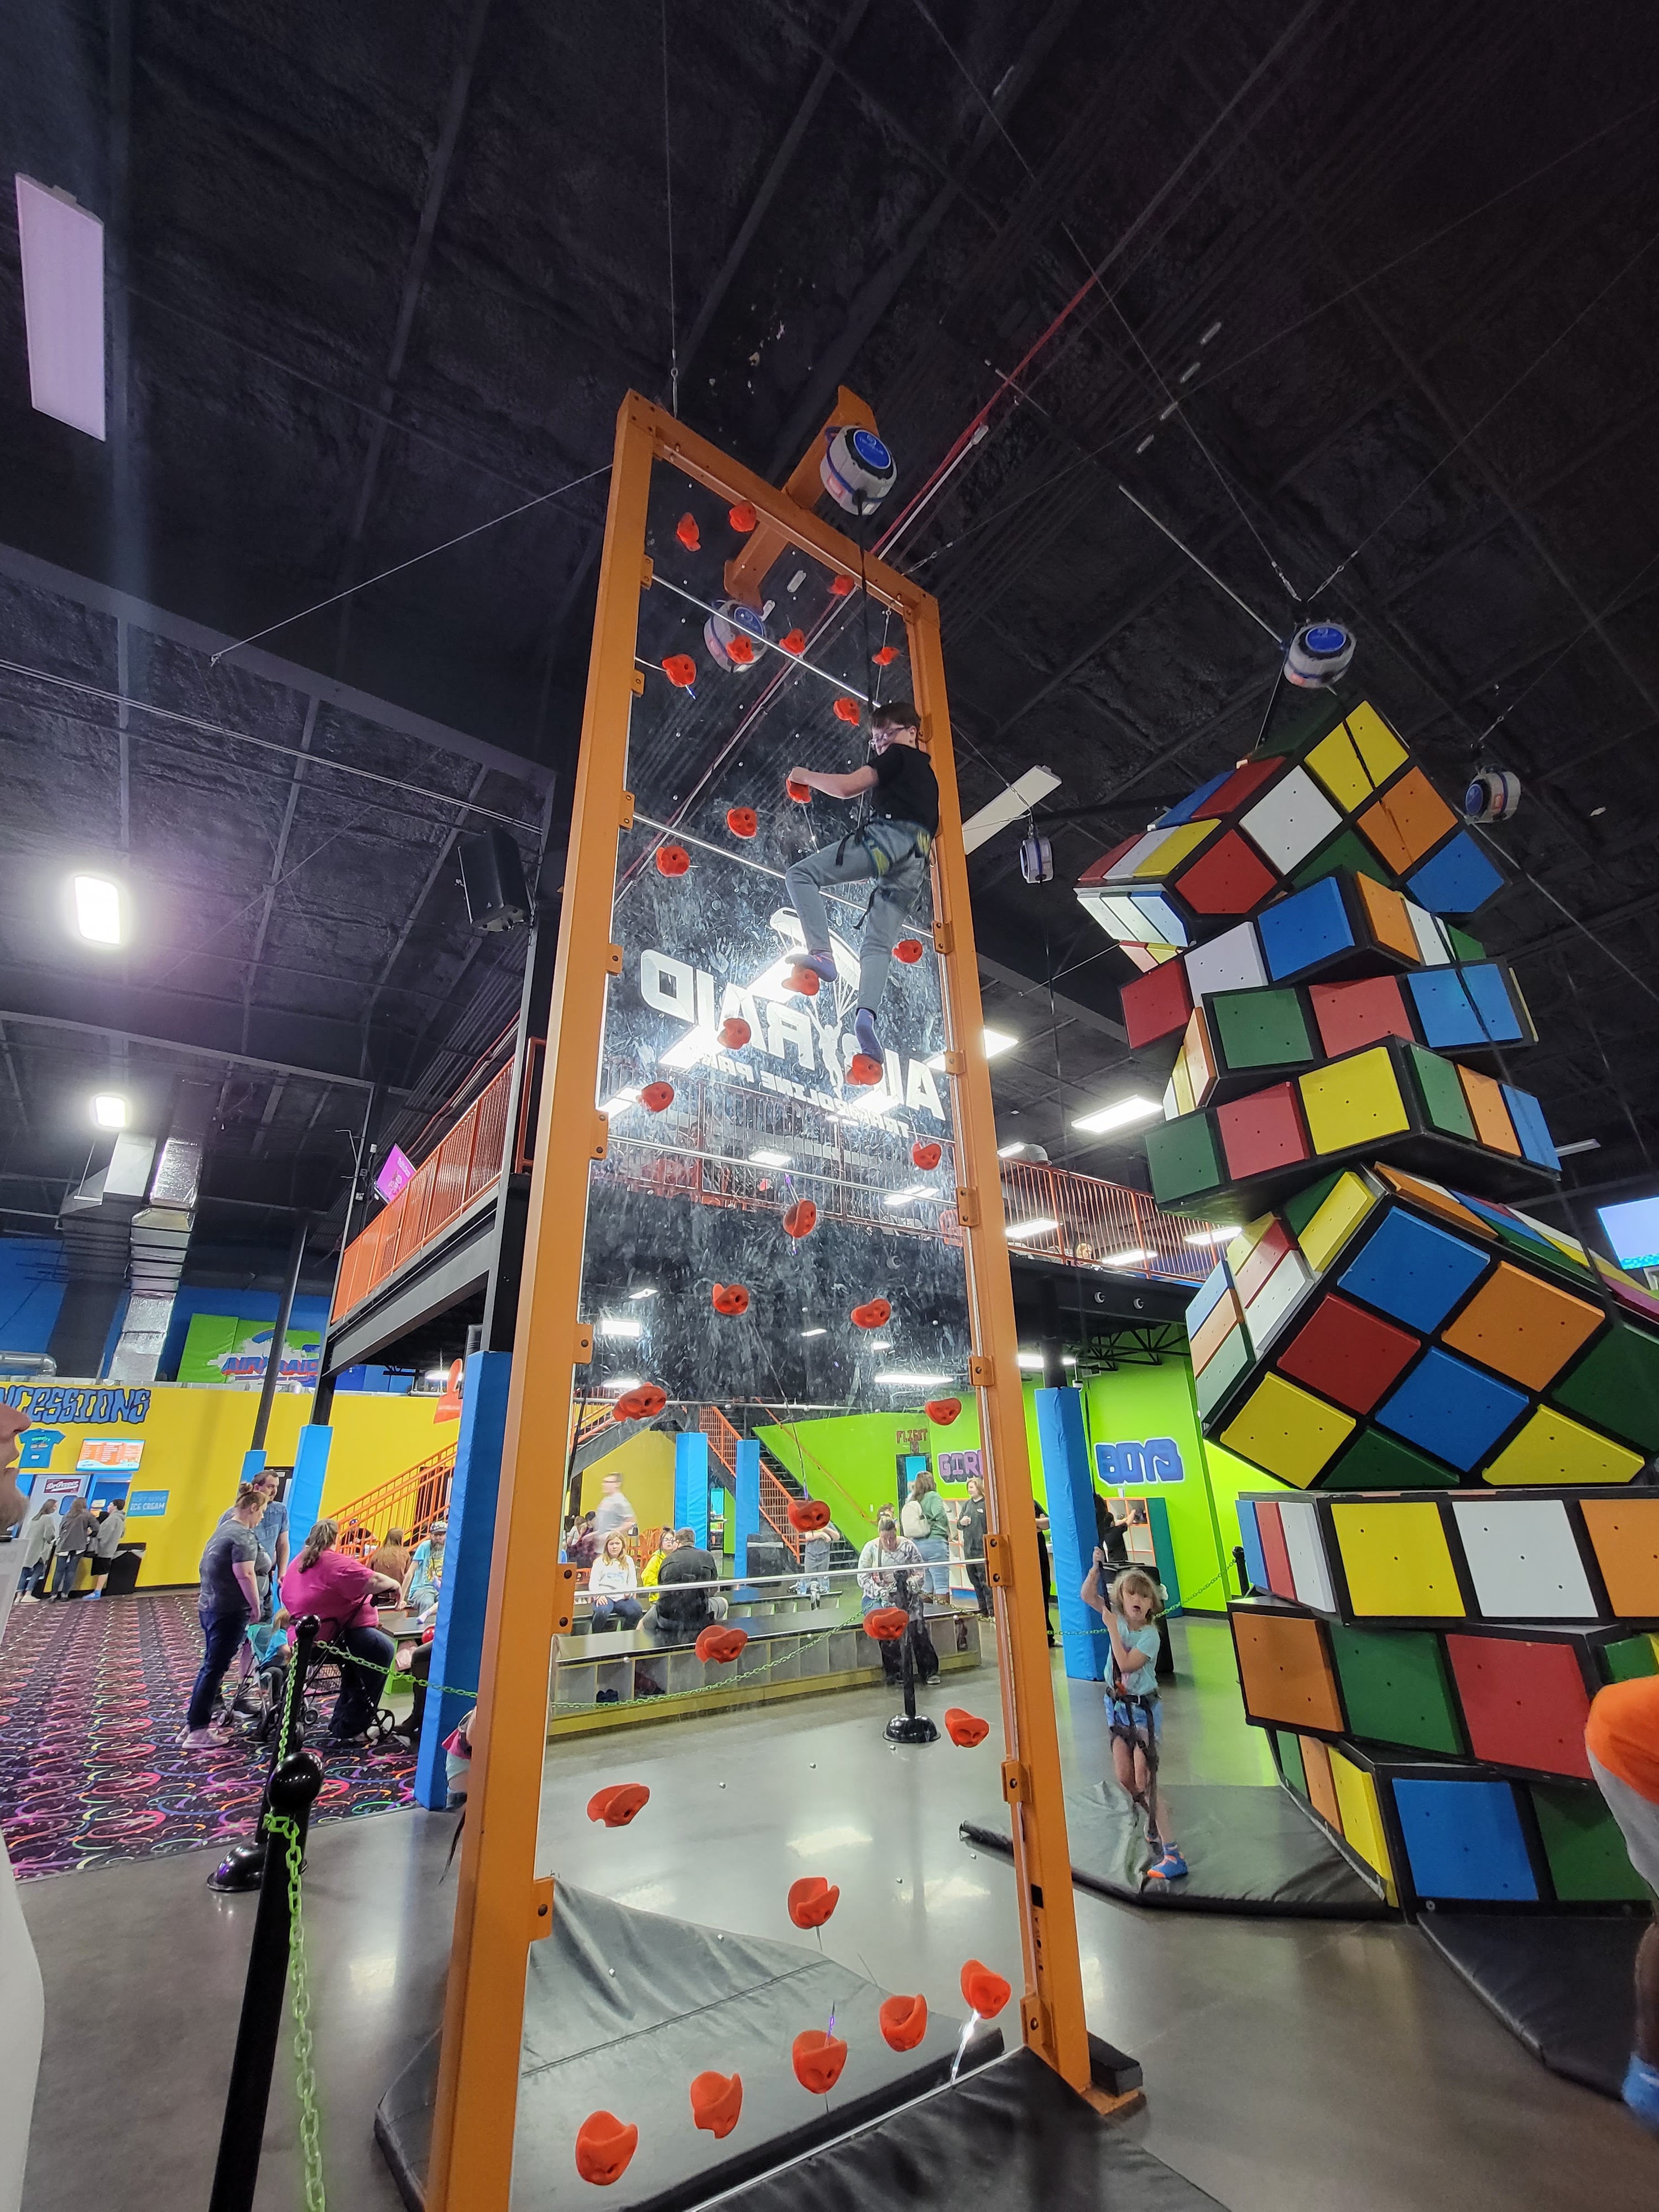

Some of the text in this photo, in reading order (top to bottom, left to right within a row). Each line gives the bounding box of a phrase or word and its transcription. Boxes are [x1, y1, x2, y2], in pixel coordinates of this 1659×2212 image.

[938, 1449, 984, 1483] GIR
[1095, 1438, 1184, 1485] BOYS
[143, 1502, 165, 1510] CREAM
